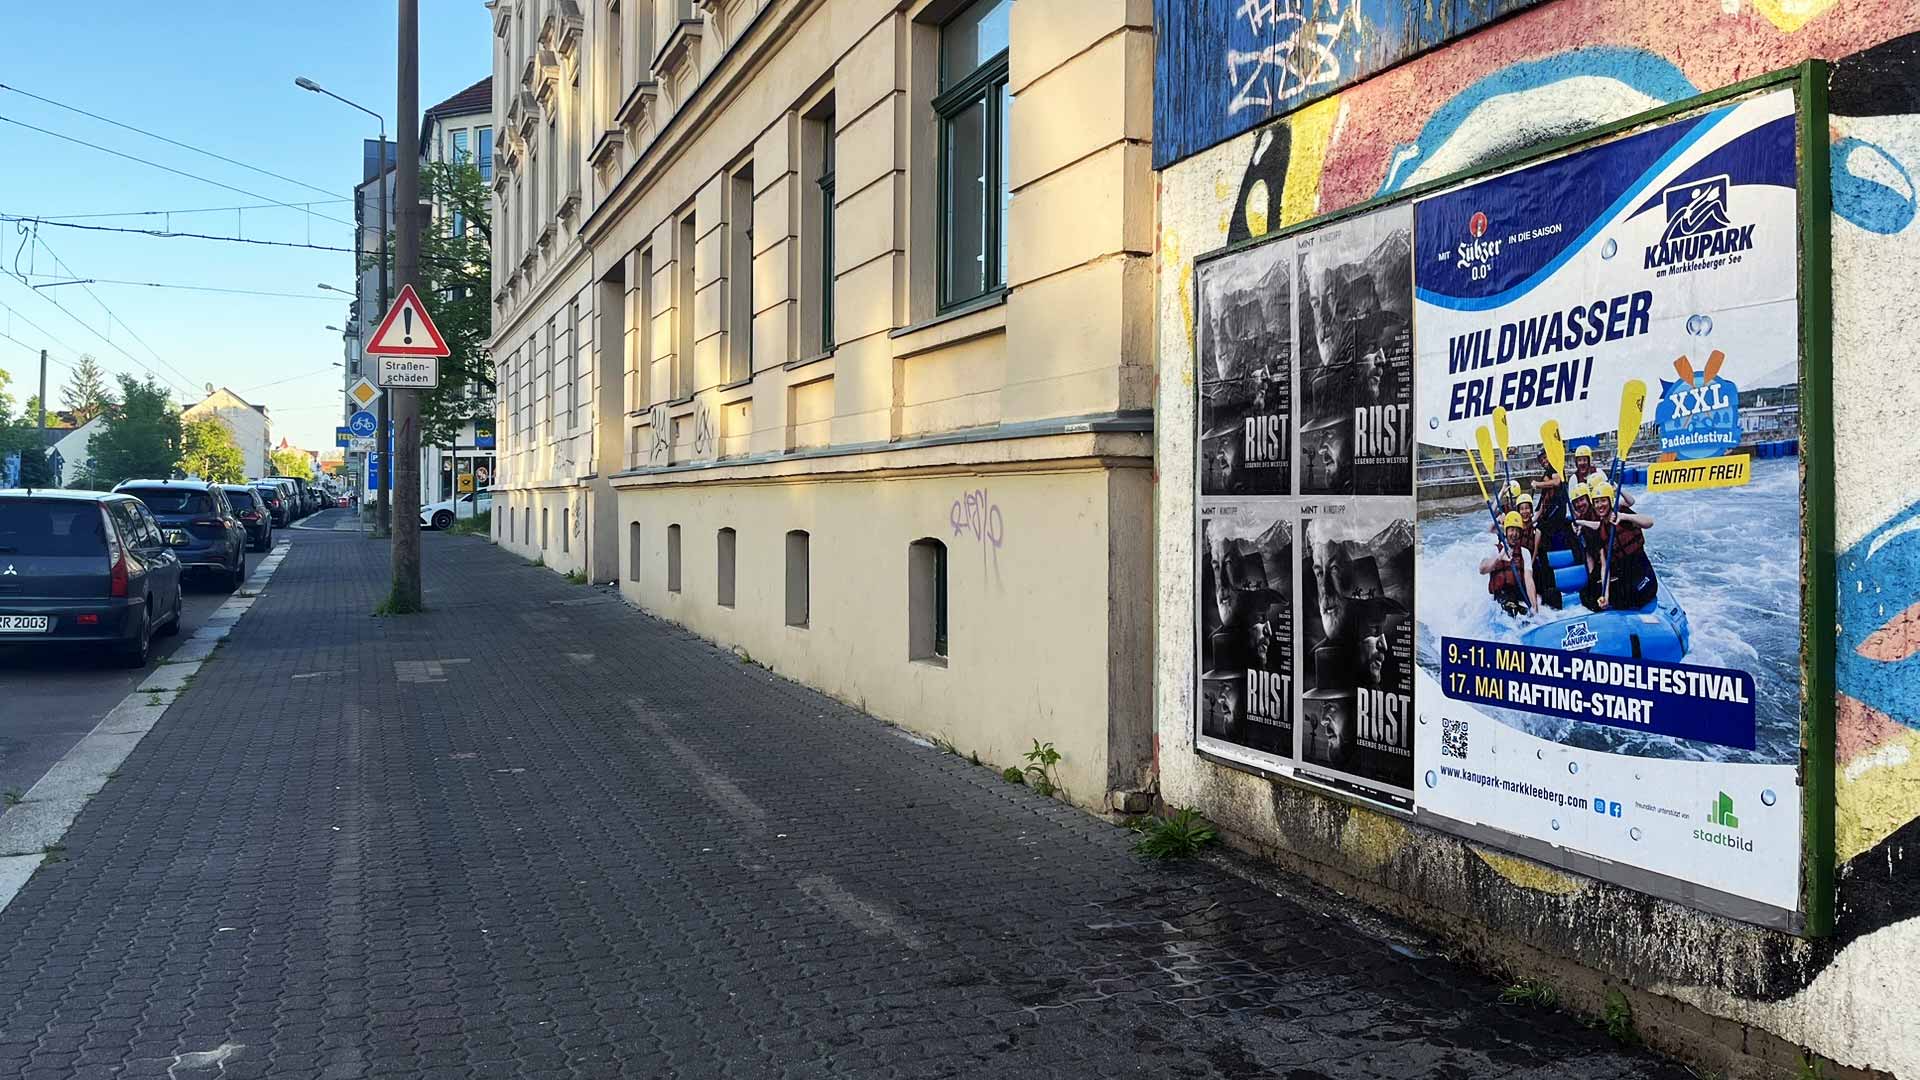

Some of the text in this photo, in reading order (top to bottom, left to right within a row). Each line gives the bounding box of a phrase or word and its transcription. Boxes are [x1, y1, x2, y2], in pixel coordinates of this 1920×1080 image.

[1438, 224, 1562, 261] MIT IN DIE SAISON
[1457, 239, 1502, 269] Lübzer
[1644, 224, 1756, 270] KANUPARK
[1656, 254, 1742, 278] am Markkleeberger See
[1448, 289, 1654, 375] WILDWASSER
[385, 361, 430, 371] Straßen-
[387, 373, 428, 382] schäden
[1448, 356, 1594, 422] ERLEBEN!
[1669, 383, 1730, 420] XXL
[1245, 414, 1289, 461] RUST
[1354, 403, 1409, 457] RUST
[1661, 430, 1733, 449] Paddelfestival
[1653, 463, 1743, 485] EINTRITT FREI!
[14, 617, 46, 629] 2003
[1562, 632, 1598, 648] KANUPARK
[1448, 643, 1749, 704] 9.-11. MAI XXL-PADDELFESTIVAL
[1247, 668, 1291, 722] RUST
[1449, 673, 1654, 725] 17. MAI RAFTING-START
[1357, 687, 1411, 748] RUST
[1440, 764, 1588, 810] www.kanupark-markkleeberg.com
[1693, 828, 1753, 853] stadtbild
